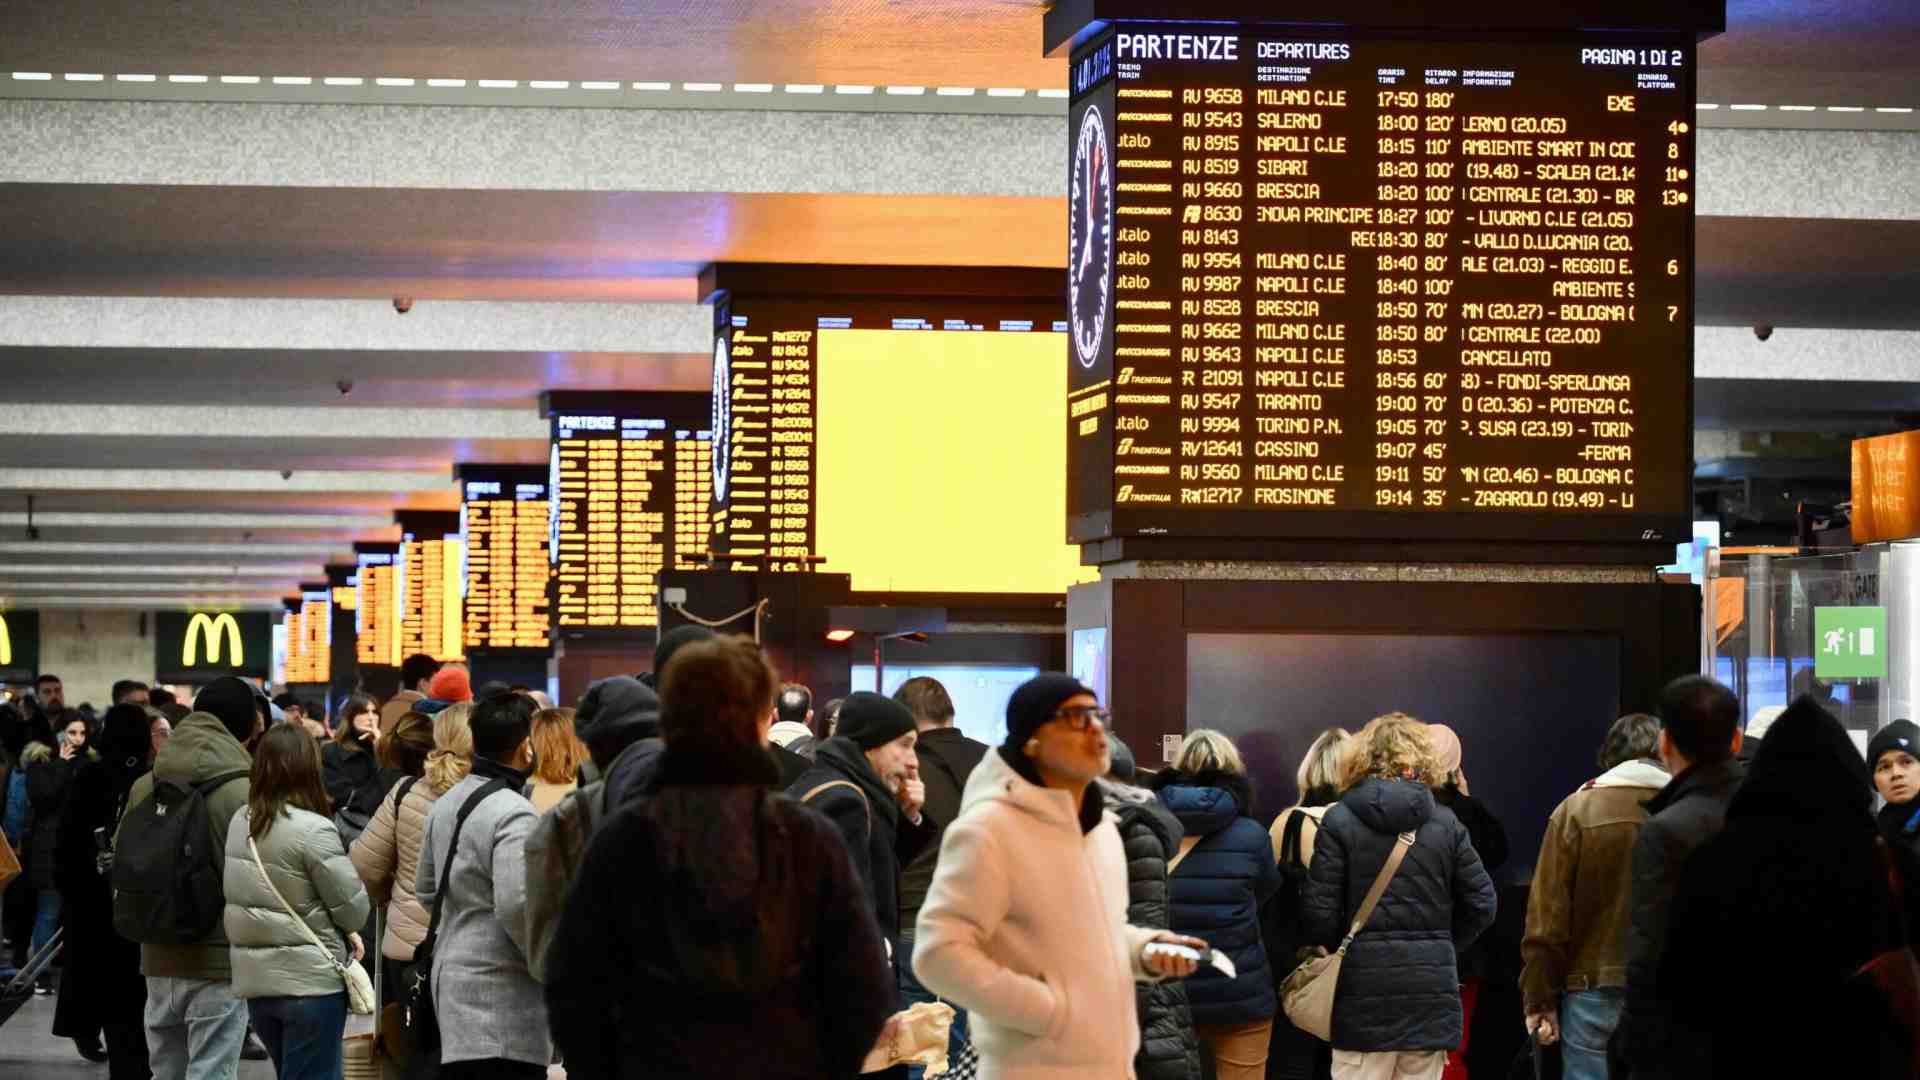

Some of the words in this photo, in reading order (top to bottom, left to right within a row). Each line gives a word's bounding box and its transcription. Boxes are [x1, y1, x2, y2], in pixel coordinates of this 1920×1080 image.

[1116, 33, 1239, 61] PARTENZE
[1257, 42, 1350, 60] DEPARTURES
[1581, 48, 1636, 65] PAGINA
[1639, 49, 1647, 66] 1
[1650, 49, 1667, 66] DI
[1671, 50, 1683, 66] 2
[1377, 76, 1396, 84] TIME
[1424, 77, 1449, 85] DELAY
[1637, 81, 1676, 89] PLATFORM
[1204, 87, 1243, 105] 9658
[1257, 88, 1311, 106] MILANO
[1314, 89, 1347, 107] C.LE
[1377, 91, 1419, 108] 17:50
[1607, 95, 1636, 112] EXE
[1204, 111, 1243, 128] 9543
[1257, 112, 1322, 130] SALERNO
[1377, 114, 1419, 132] 18:00
[1511, 116, 1567, 134] (20.05)
[1204, 134, 1240, 152] 8915
[1257, 135, 1310, 153] NAPOLI
[1314, 136, 1347, 153] C.LE
[1377, 137, 1415, 155] 18:15
[1462, 139, 1533, 157] AMBIENTE
[1537, 140, 1585, 157] SMART
[1588, 141, 1606, 158] IN
[1668, 143, 1677, 159] 8
[1203, 158, 1240, 175] 8519
[1257, 159, 1308, 176] SIBARI
[1377, 161, 1419, 178] 18:20
[1466, 162, 1519, 180] (19.48)
[1536, 164, 1591, 181] SCALEA
[1203, 181, 1243, 199] 9660
[1256, 182, 1320, 200] BRESCIA
[1377, 184, 1418, 201] 18:20
[1469, 186, 1542, 204] CENTRALE
[1546, 187, 1598, 204] (21.30)
[1202, 204, 1243, 224] 8630
[1304, 206, 1374, 224] PRINCIPE
[1377, 207, 1418, 225] 18:27
[1479, 209, 1541, 227] LIVORNO
[1544, 210, 1577, 228] C.LE
[1581, 211, 1633, 228] (21.05)
[1203, 228, 1239, 245] 8143
[1377, 231, 1418, 248] 18:30
[1474, 233, 1520, 250] VALLO
[1522, 233, 1600, 251] D.LUCANIA
[1203, 252, 1242, 269] 9954
[1256, 252, 1310, 270] MILANO
[1313, 253, 1346, 271] C.LE
[1376, 254, 1418, 271] 18:40
[1492, 256, 1545, 273] (21.03)
[1562, 257, 1616, 275] REGGIO
[1619, 258, 1633, 275] E.
[1668, 260, 1678, 276] 6
[1203, 275, 1242, 292] 9987
[1256, 276, 1309, 293] NAPOLI
[1313, 277, 1346, 294] C.LE
[1376, 278, 1418, 295] 18:40
[1552, 280, 1624, 298] AMBIENTE
[1202, 299, 1242, 316] 8528
[1256, 299, 1319, 317] BRESCIA
[1376, 301, 1418, 319] 18:50
[1487, 303, 1544, 320] (20.27)
[1560, 304, 1625, 321] BOLOGNA
[1668, 306, 1677, 321] 7
[1202, 322, 1242, 339] 9662
[1255, 323, 1310, 340] MILANO
[1312, 323, 1345, 341] C.LE
[1376, 324, 1418, 342] 18:50
[1468, 326, 1541, 344] CENTRALE
[1545, 327, 1601, 345] (22.00)
[1202, 345, 1241, 363] 9643
[1255, 346, 1308, 364] NAPOLI
[1312, 347, 1345, 365] C.LE
[1376, 348, 1417, 365] 18:53
[1461, 349, 1552, 367] CANCELLATO
[1202, 369, 1244, 387] 21091
[1255, 370, 1308, 388] NAPOLI
[1312, 370, 1345, 388] C.LE
[1376, 372, 1417, 389] 18:56
[1497, 373, 1631, 392] FONDI-SPERLONGA
[1202, 392, 1241, 410] 9547
[1255, 393, 1322, 411] TARANTO
[1375, 395, 1417, 412] 19:00
[1477, 396, 1533, 414] (20.36)
[1550, 397, 1616, 415] POTENZA
[1618, 398, 1634, 415] C.
[1202, 416, 1241, 433] 9994
[1255, 417, 1310, 434] TORINO
[1313, 417, 1343, 435] P.N.
[1375, 418, 1417, 436] 19:05
[1478, 420, 1517, 437] SUSA
[1521, 420, 1573, 437] (23.19)
[1255, 440, 1319, 458] CASSINO
[1375, 442, 1417, 459] 19:07
[1201, 463, 1241, 480] 9560
[1254, 464, 1308, 481] MILANO
[1311, 464, 1345, 482] C.LE
[1375, 465, 1409, 483] 19:11
[1483, 466, 1539, 484] (20.46)
[1556, 467, 1621, 485] BOLOGNA
[1254, 487, 1336, 505] FROSINONE
[1375, 489, 1413, 506] 19:14
[1474, 490, 1548, 507] ZAGAROLO
[1552, 491, 1605, 508] (19.49)
